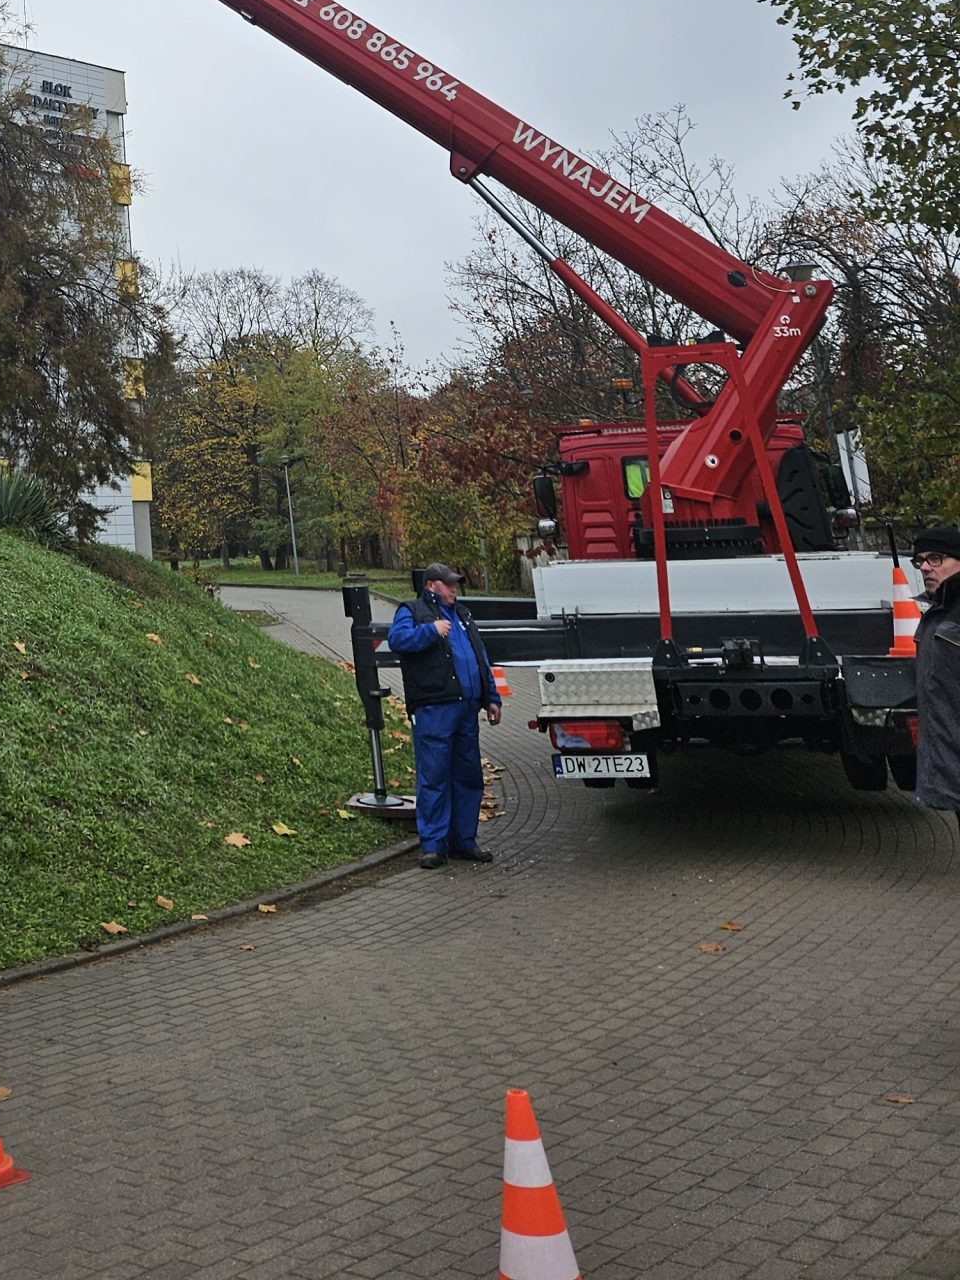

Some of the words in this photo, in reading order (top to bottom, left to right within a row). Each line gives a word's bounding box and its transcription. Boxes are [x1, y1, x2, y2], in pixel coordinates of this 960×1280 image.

[319, 2, 367, 40] 608
[366, 32, 415, 70] 865
[412, 61, 460, 102] 964
[42, 80, 73, 99] BLOK
[512, 120, 652, 224] WYNAJEM
[772, 326, 802, 337] 33m
[564, 757, 587, 773] DW
[591, 756, 645, 773] 2TE23
